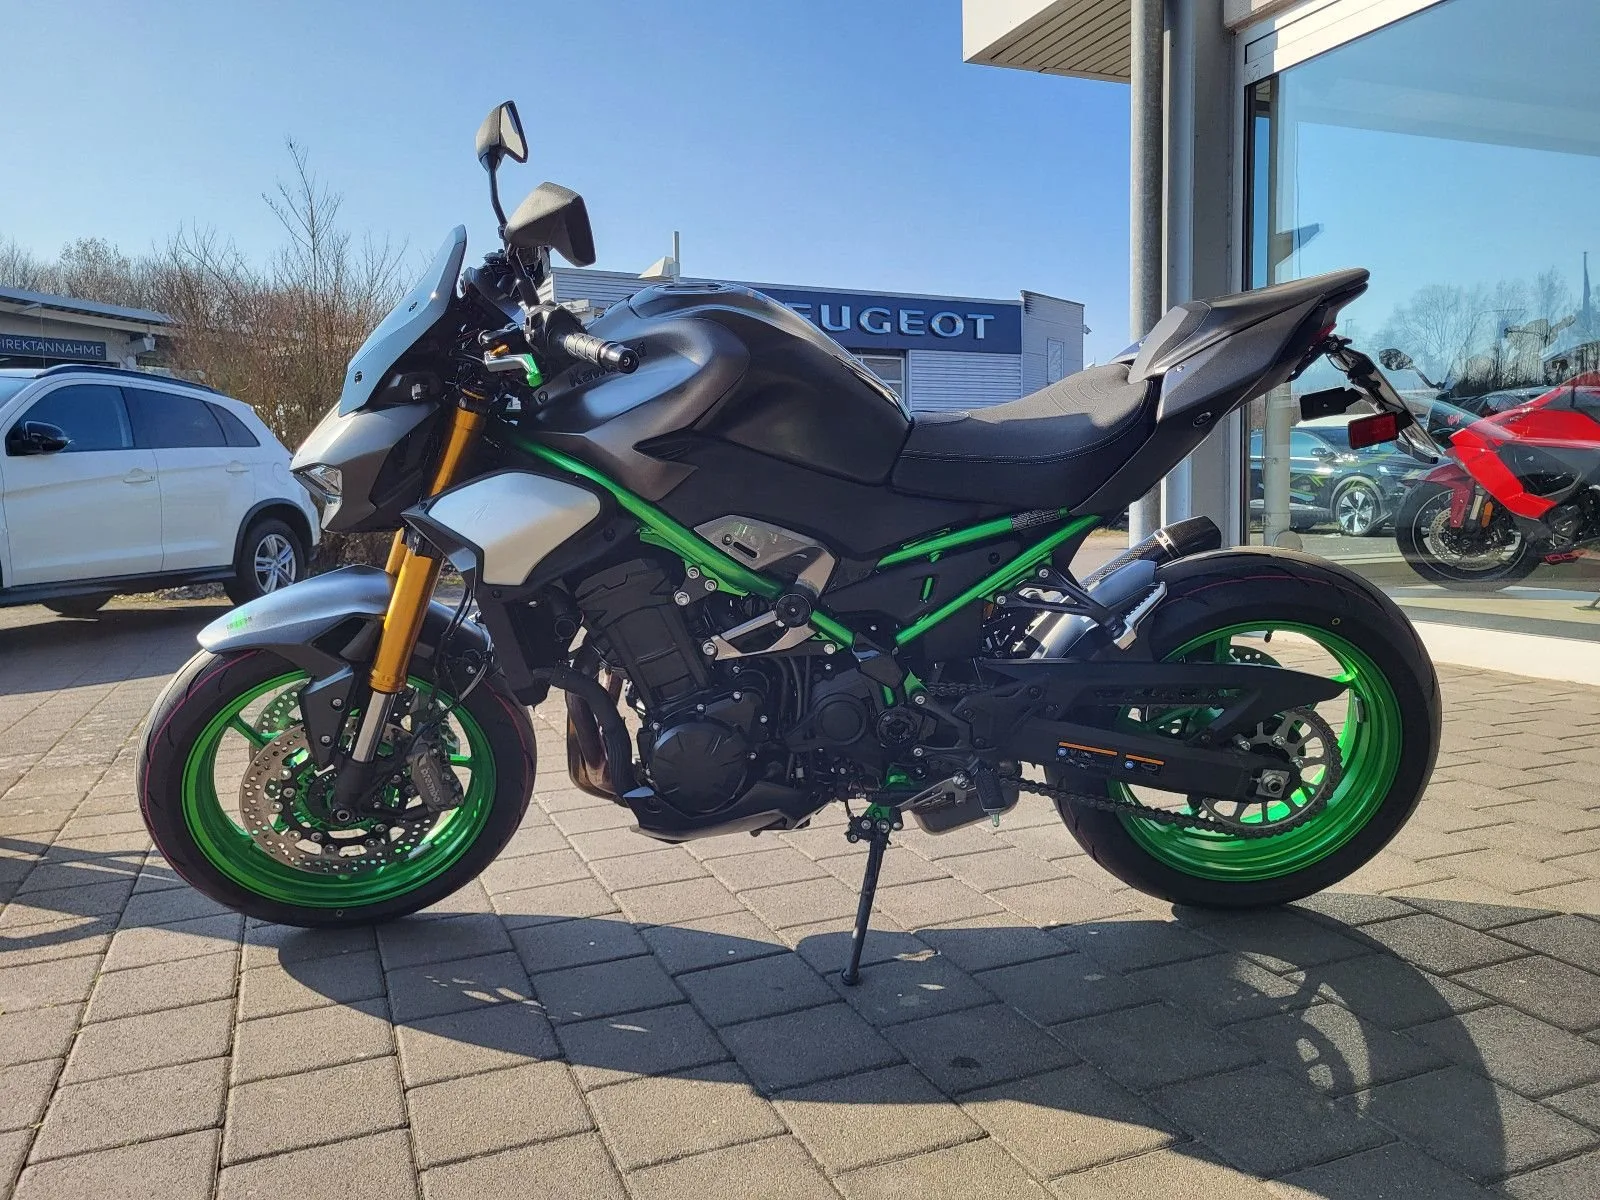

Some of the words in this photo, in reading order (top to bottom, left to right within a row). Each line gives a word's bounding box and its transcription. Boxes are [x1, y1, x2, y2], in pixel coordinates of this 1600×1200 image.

[785, 302, 995, 340] UGEOT
[0, 338, 102, 356] IREKTANNAHME
[420, 767, 441, 803] brembo
